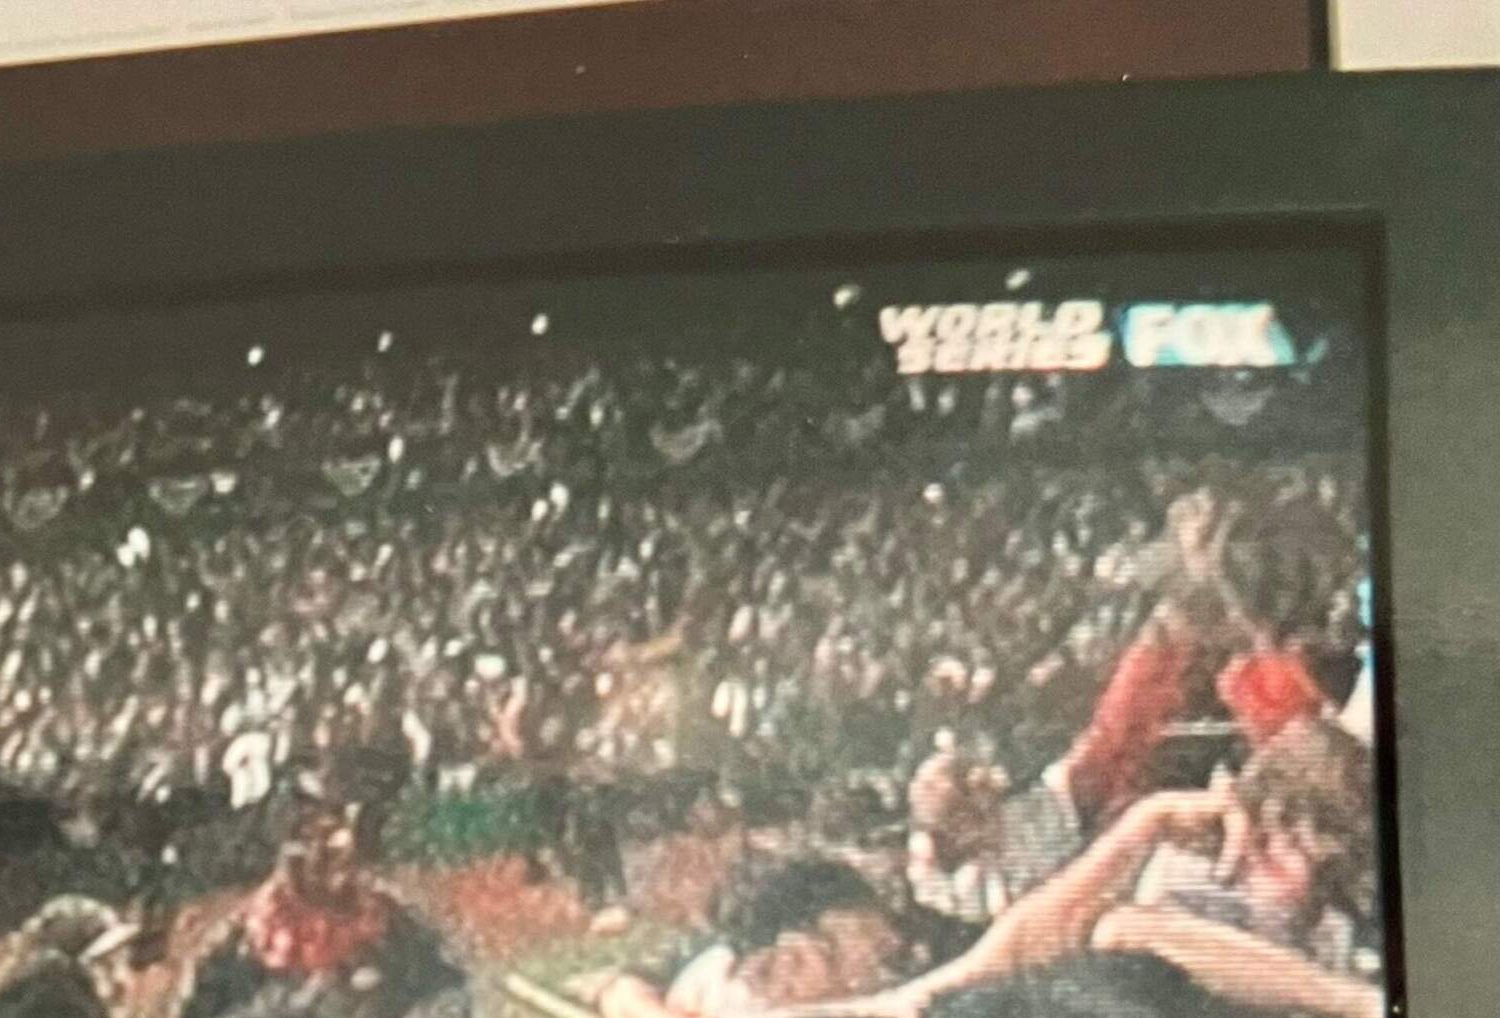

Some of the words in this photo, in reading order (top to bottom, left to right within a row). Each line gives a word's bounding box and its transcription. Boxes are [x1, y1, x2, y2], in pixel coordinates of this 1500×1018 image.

[879, 300, 1102, 342] WORLD
[1121, 302, 1275, 368] FOX
[897, 332, 1111, 374] SERIES
